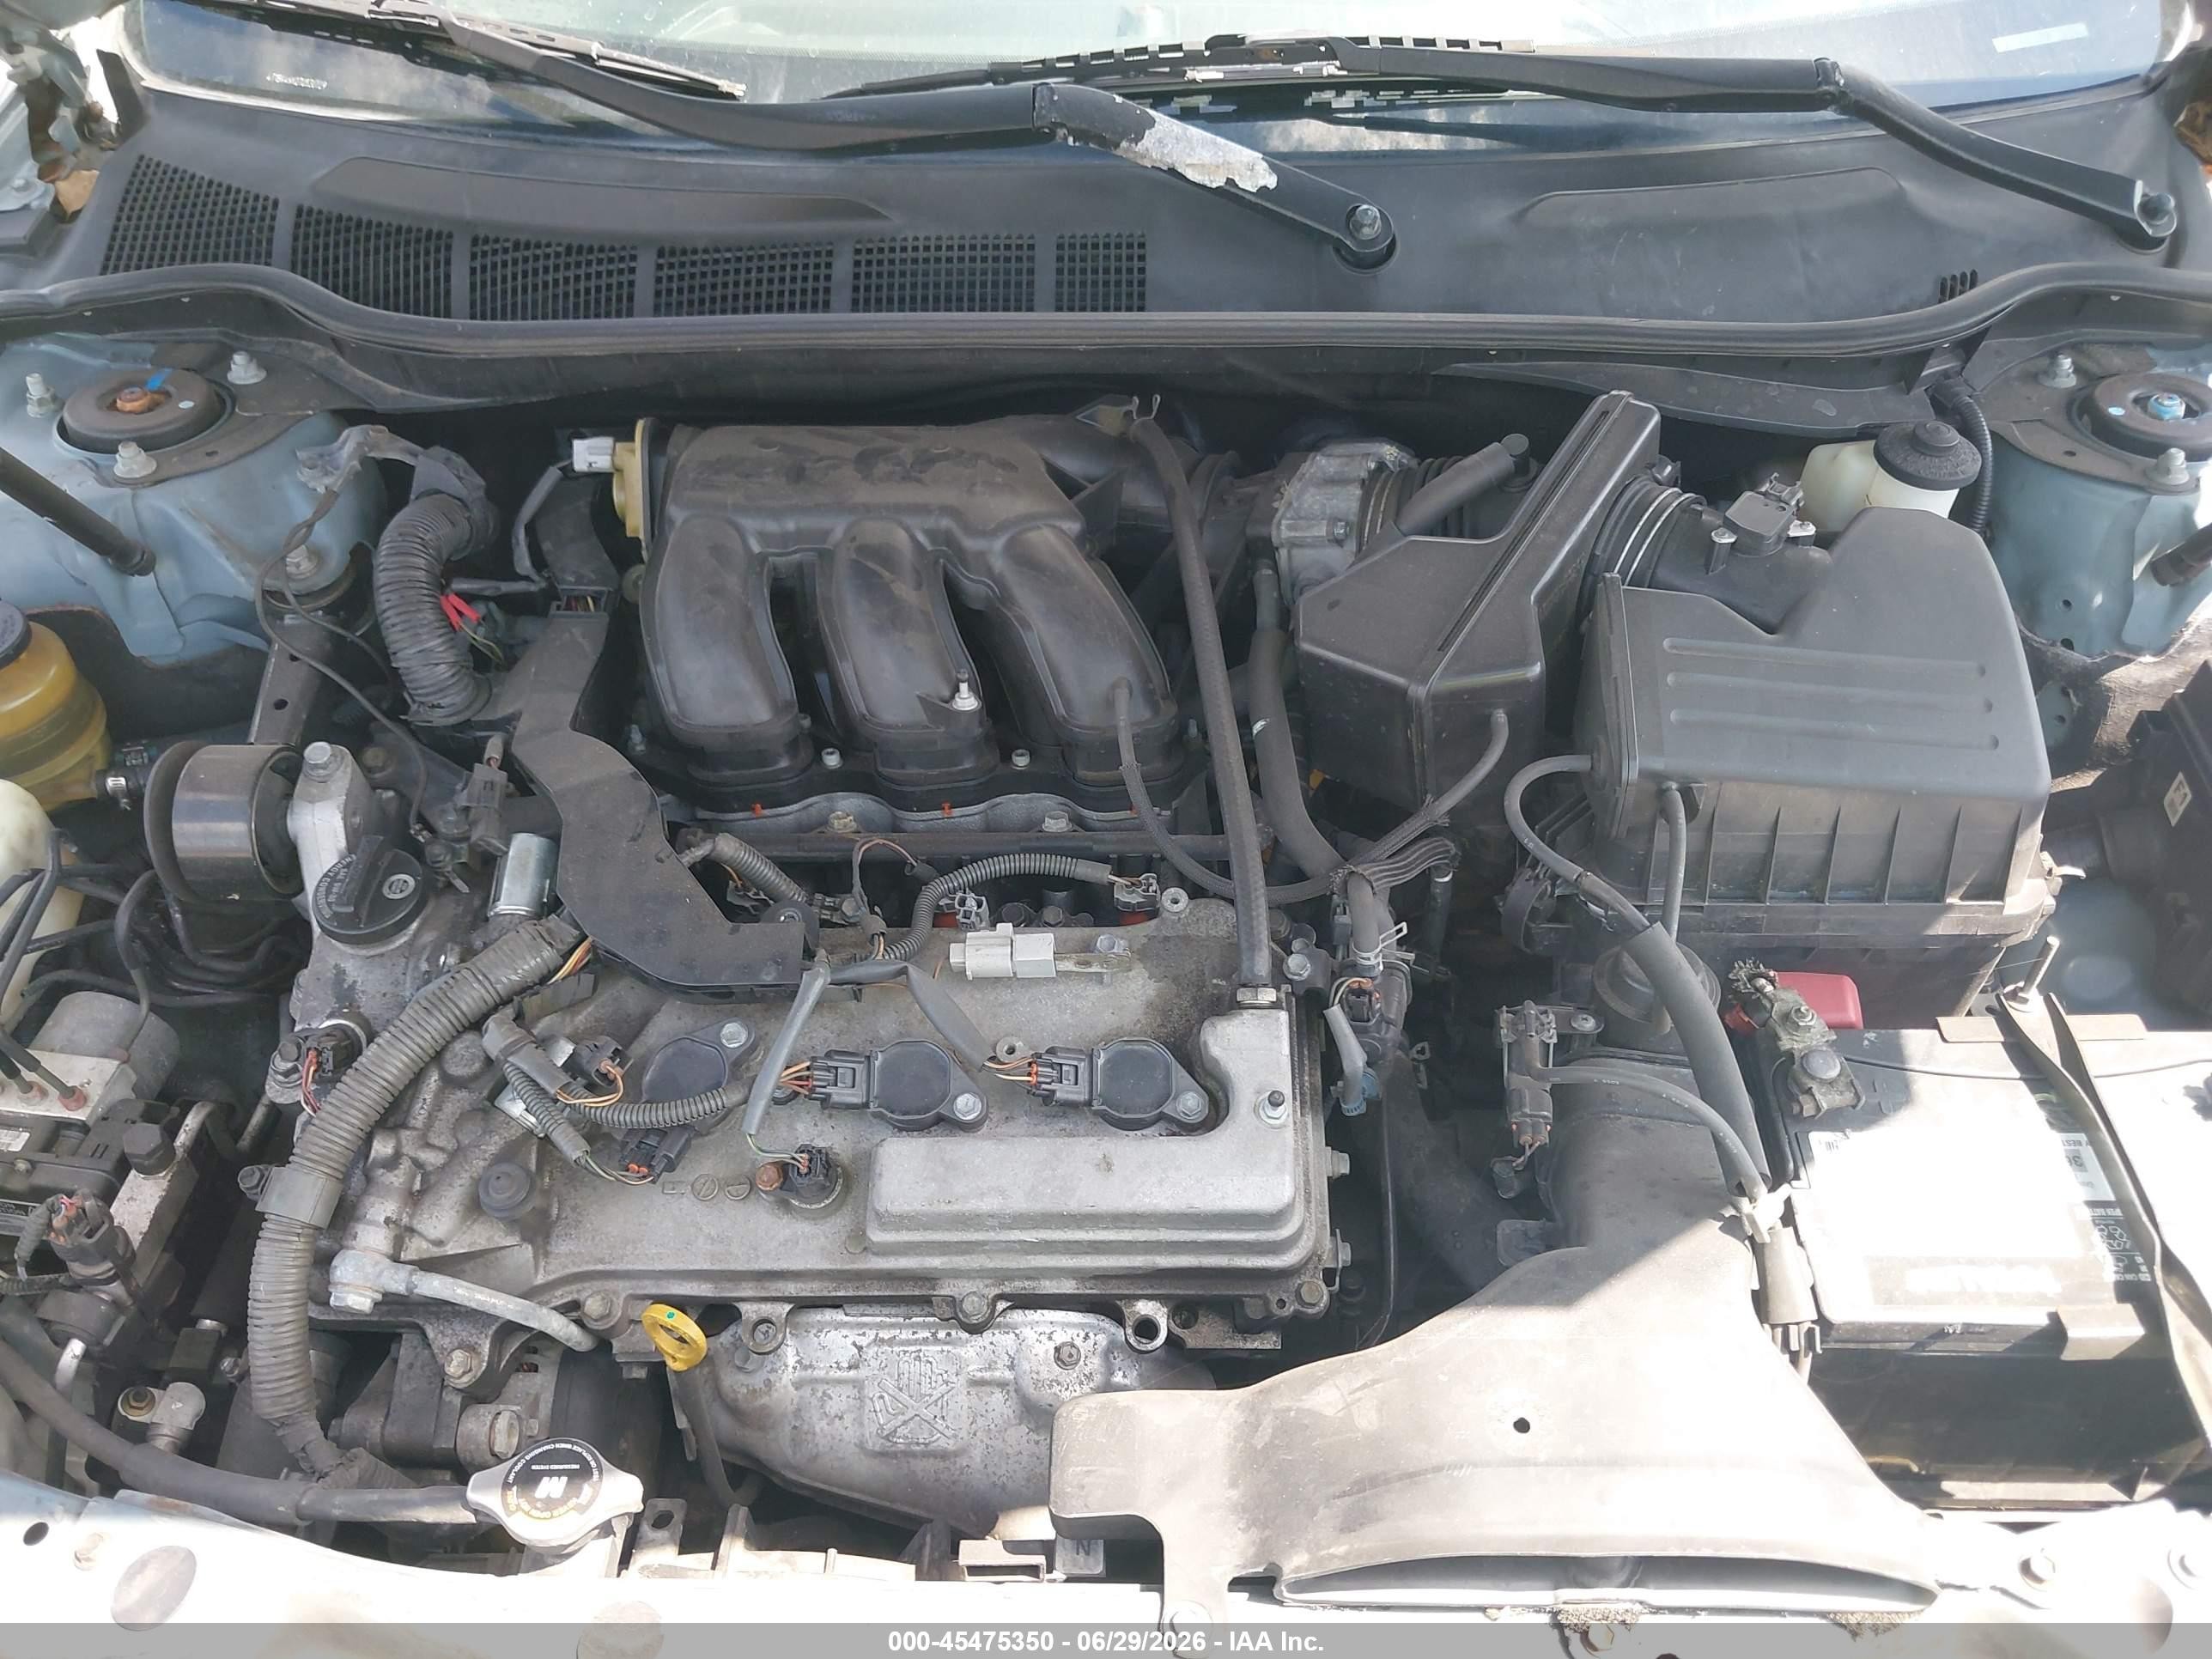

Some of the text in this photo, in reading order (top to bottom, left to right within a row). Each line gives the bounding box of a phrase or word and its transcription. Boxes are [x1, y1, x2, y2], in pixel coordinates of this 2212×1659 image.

[326, 854, 356, 877] ENERGY
[525, 1443, 555, 1461] CHANGING
[507, 1459, 526, 1484] COOLANT
